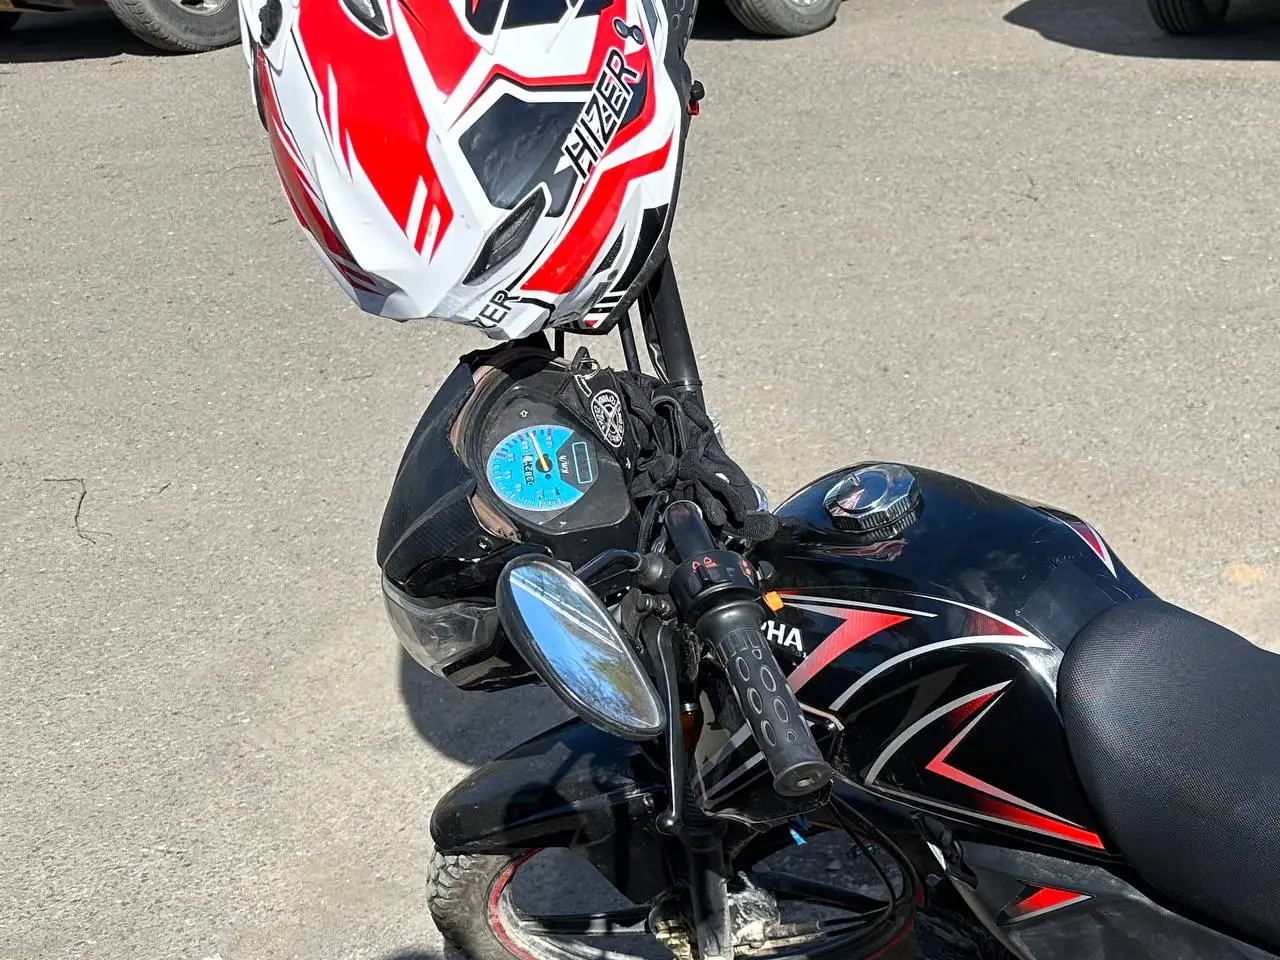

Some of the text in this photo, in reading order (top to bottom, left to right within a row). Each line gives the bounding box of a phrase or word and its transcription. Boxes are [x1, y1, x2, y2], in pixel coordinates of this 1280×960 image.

[564, 48, 638, 180] HIZER
[558, 455, 570, 474] Km/h
[760, 620, 803, 652] HA
